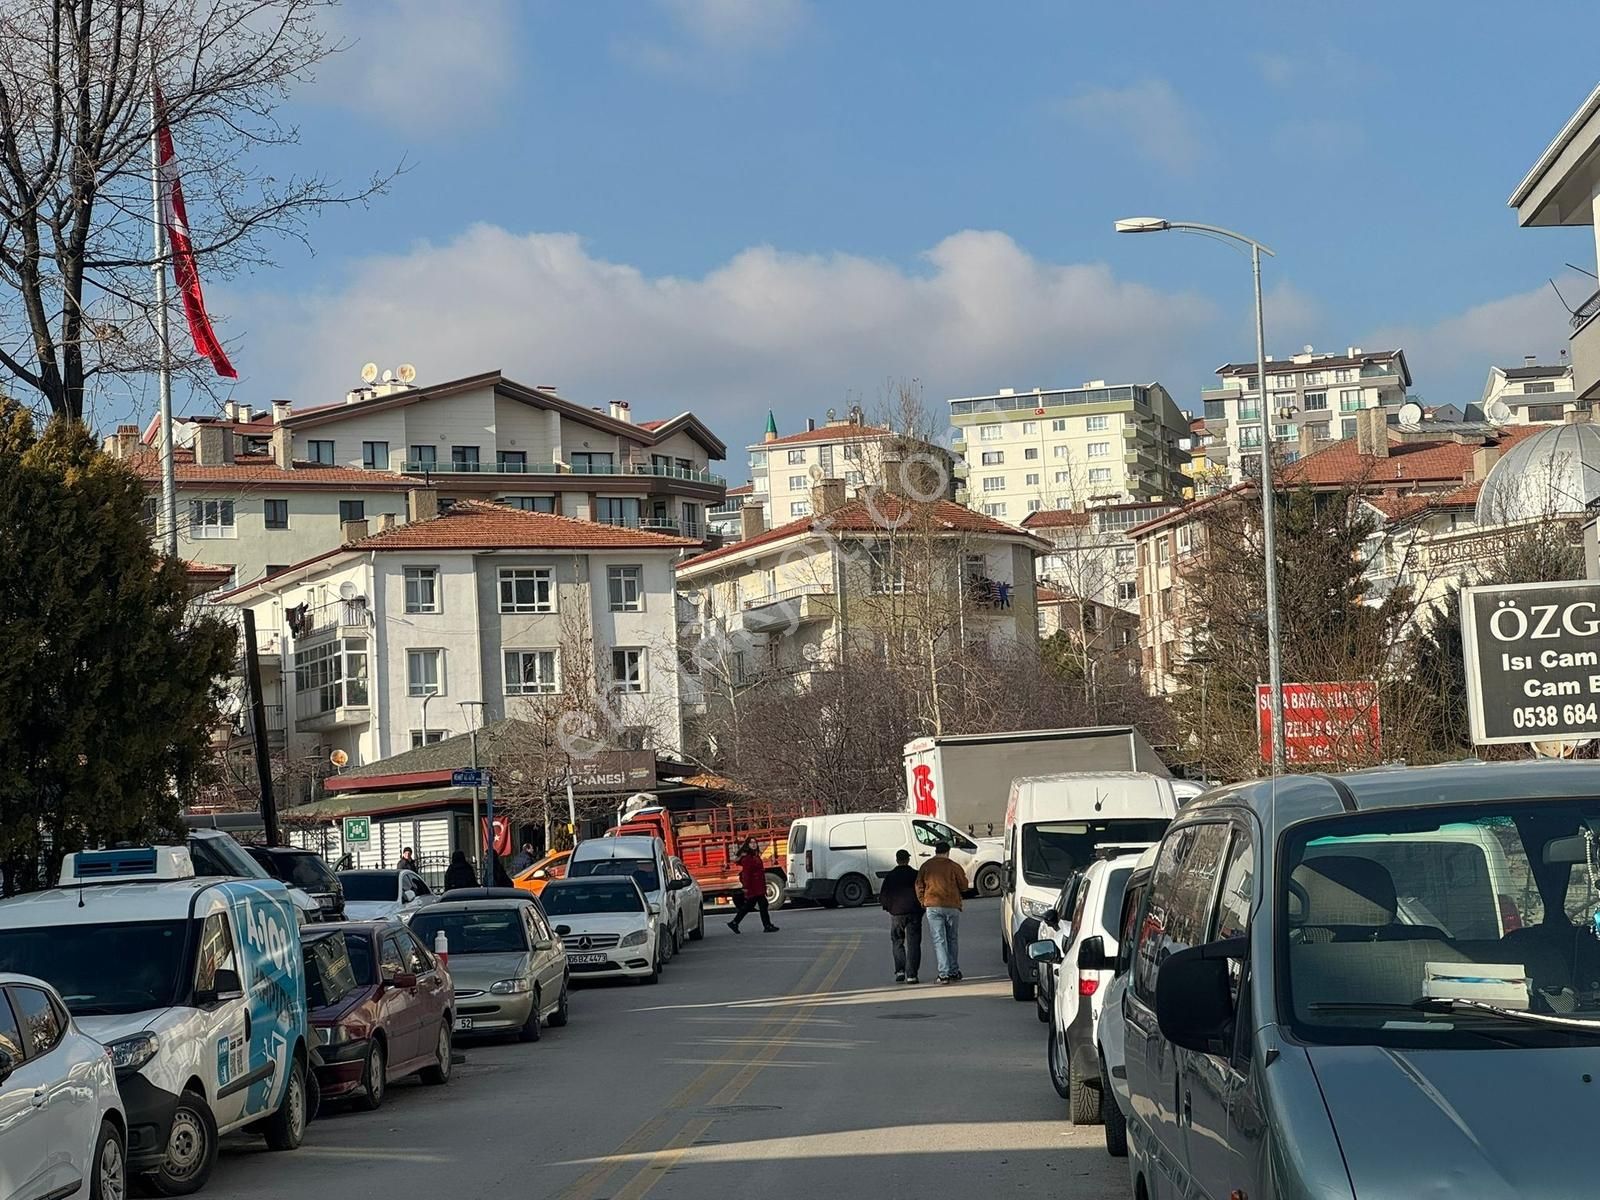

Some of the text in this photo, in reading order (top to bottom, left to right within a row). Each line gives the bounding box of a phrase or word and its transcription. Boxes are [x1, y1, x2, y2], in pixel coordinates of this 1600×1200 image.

[1502, 650, 1598, 671] Isı Cam
[1523, 679, 1581, 698] Cam
[1513, 703, 1598, 728] 0538 684
[555, 764, 601, 776] MLLET
[461, 1018, 471, 1029] 52
